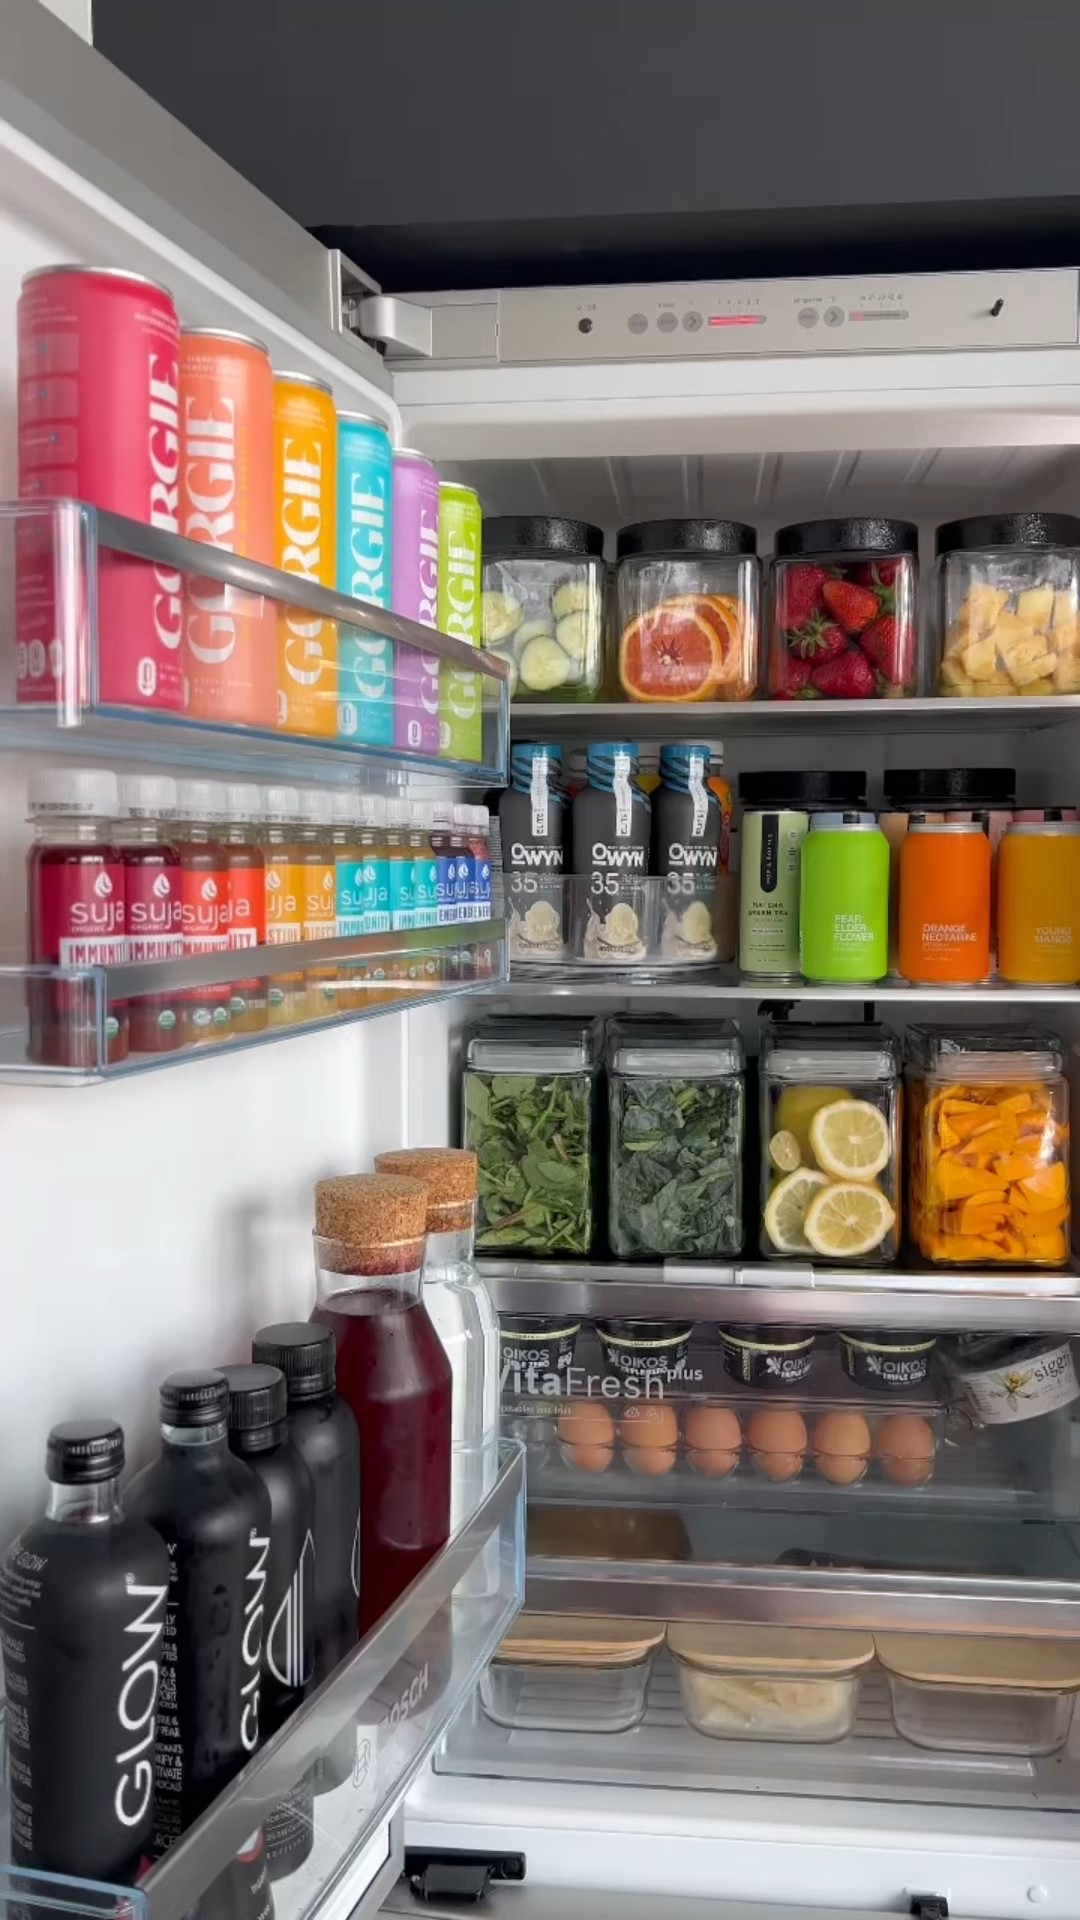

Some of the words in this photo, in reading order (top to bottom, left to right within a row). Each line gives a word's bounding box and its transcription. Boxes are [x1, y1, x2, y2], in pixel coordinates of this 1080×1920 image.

[511, 842, 564, 867] OWYN
[592, 842, 645, 868] OWYN
[668, 842, 718, 868] OWYN
[511, 870, 538, 893] 35
[591, 871, 619, 895] 35
[667, 871, 695, 894] 35
[834, 923, 867, 932] ELDER
[834, 932, 875, 942] FLOWER
[921, 932, 978, 942] NECTARINE
[922, 923, 967, 933] ORANGE
[503, 1346, 550, 1362] OIKOS
[620, 1354, 669, 1369] OIKOS
[667, 1366, 704, 1383] plus
[240, 1537, 270, 1751] GLOW
[114, 1584, 168, 1827] GLOW
